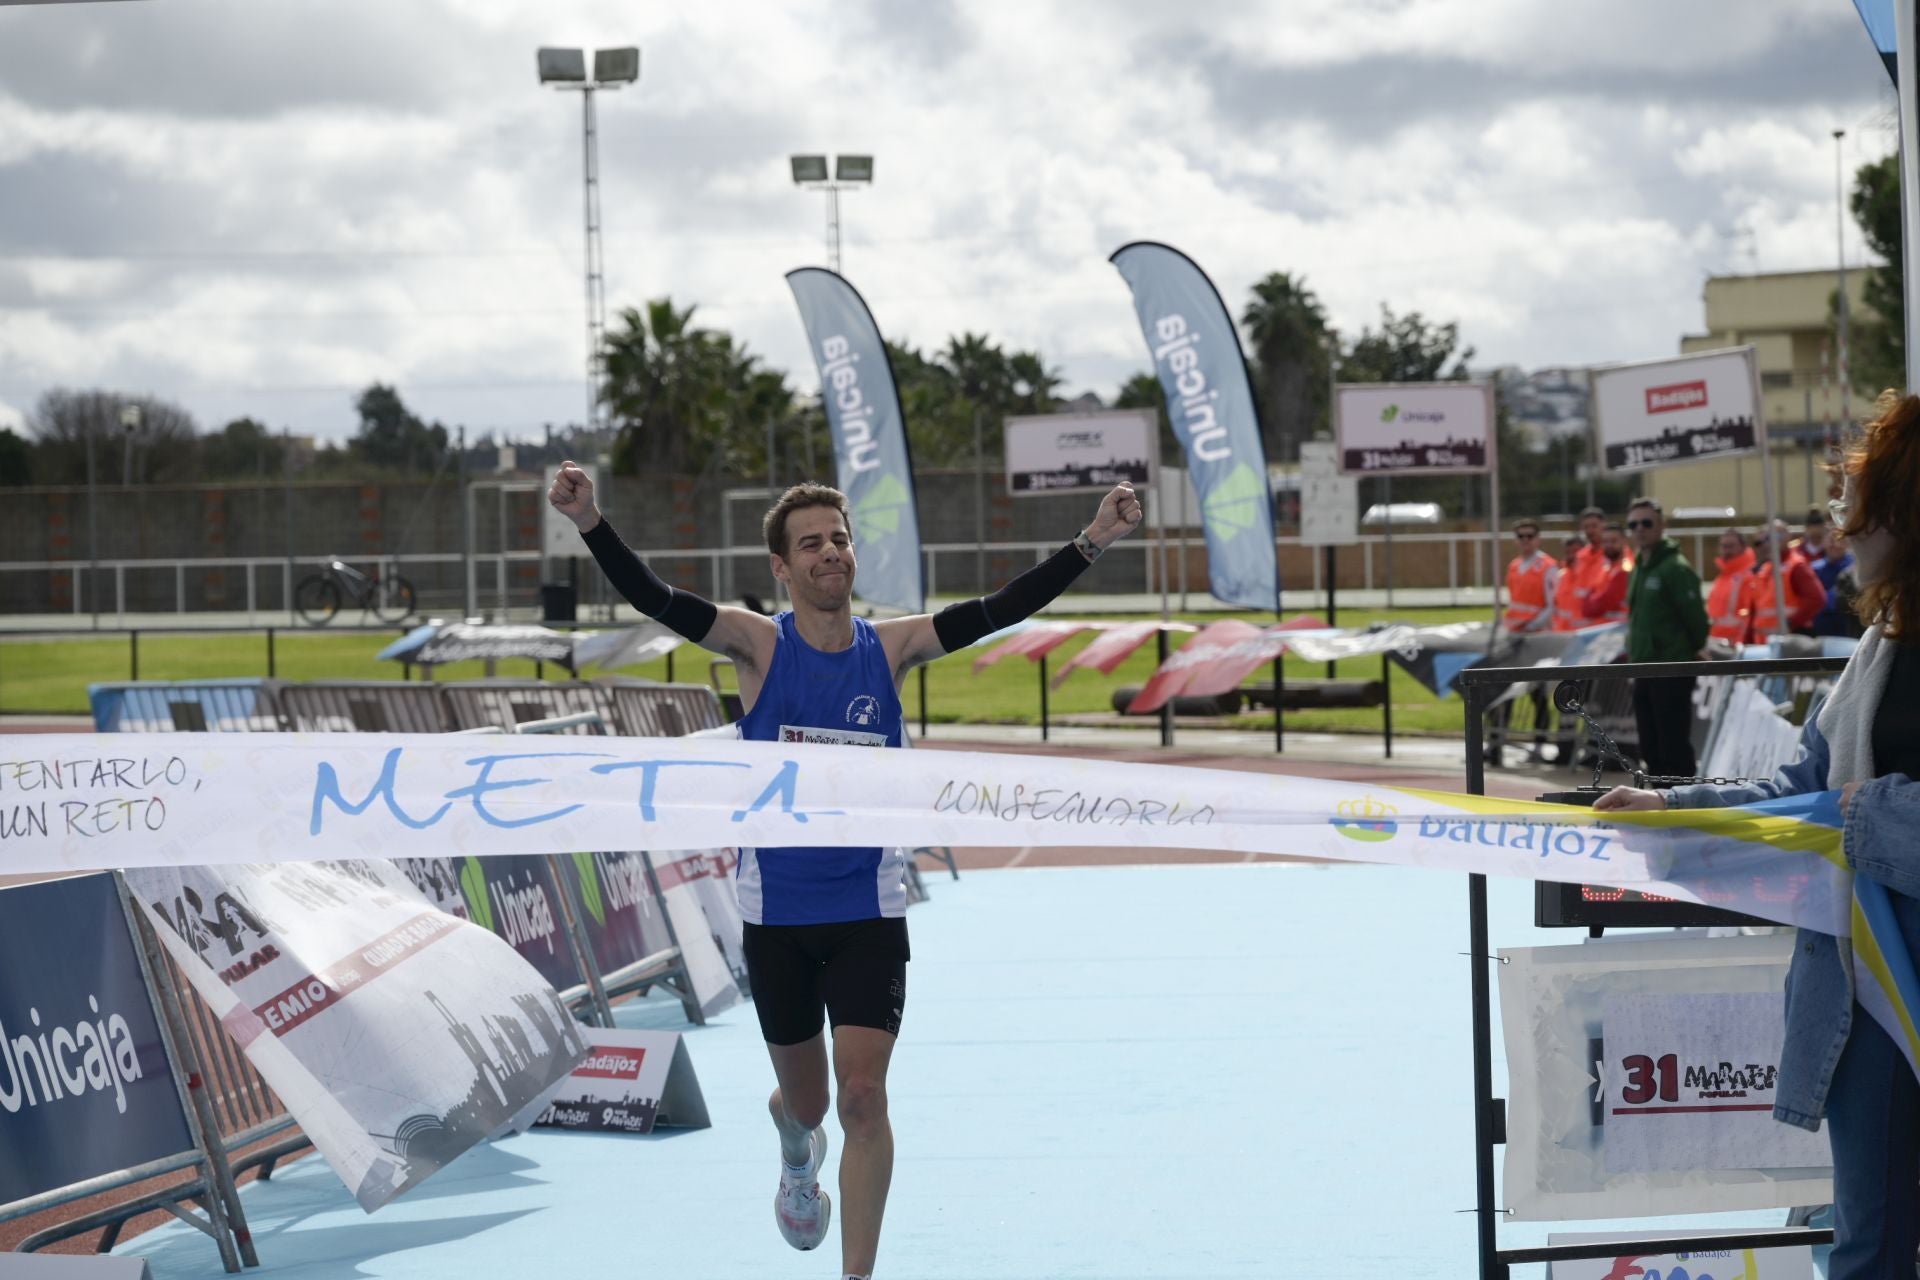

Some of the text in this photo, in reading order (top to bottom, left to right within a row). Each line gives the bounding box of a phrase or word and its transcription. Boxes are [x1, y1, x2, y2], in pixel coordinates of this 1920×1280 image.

[784, 729, 804, 743] 31
[309, 747, 846, 836] META
[0, 796, 166, 839] UN RETO
[490, 869, 557, 955] Unicaja
[1622, 1053, 1679, 1104] 31
[1699, 1090, 1748, 1099] POPULAR
[602, 1107, 613, 1125] 9
